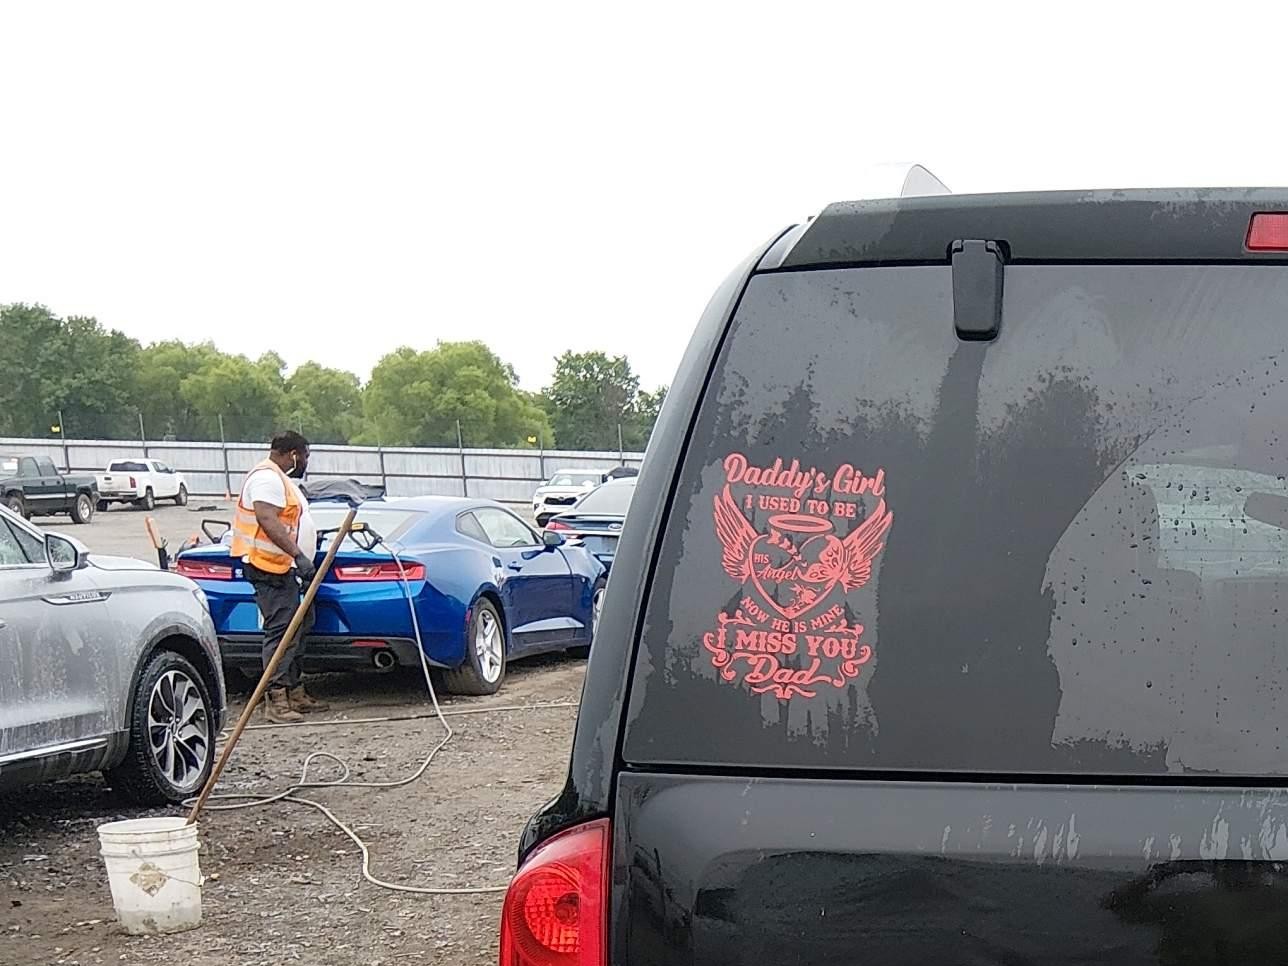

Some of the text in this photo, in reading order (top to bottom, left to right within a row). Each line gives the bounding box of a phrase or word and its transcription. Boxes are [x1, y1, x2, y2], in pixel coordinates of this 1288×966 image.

[724, 453, 886, 497] Daddy's Girl
[745, 495, 857, 518] I USED TO BE
[754, 552, 769, 564] HIS
[755, 565, 799, 581] Angel
[740, 596, 844, 633] NOW HE IS MINE
[735, 629, 798, 654] MISS
[805, 635, 858, 659] YOU
[738, 651, 832, 684] Dad
